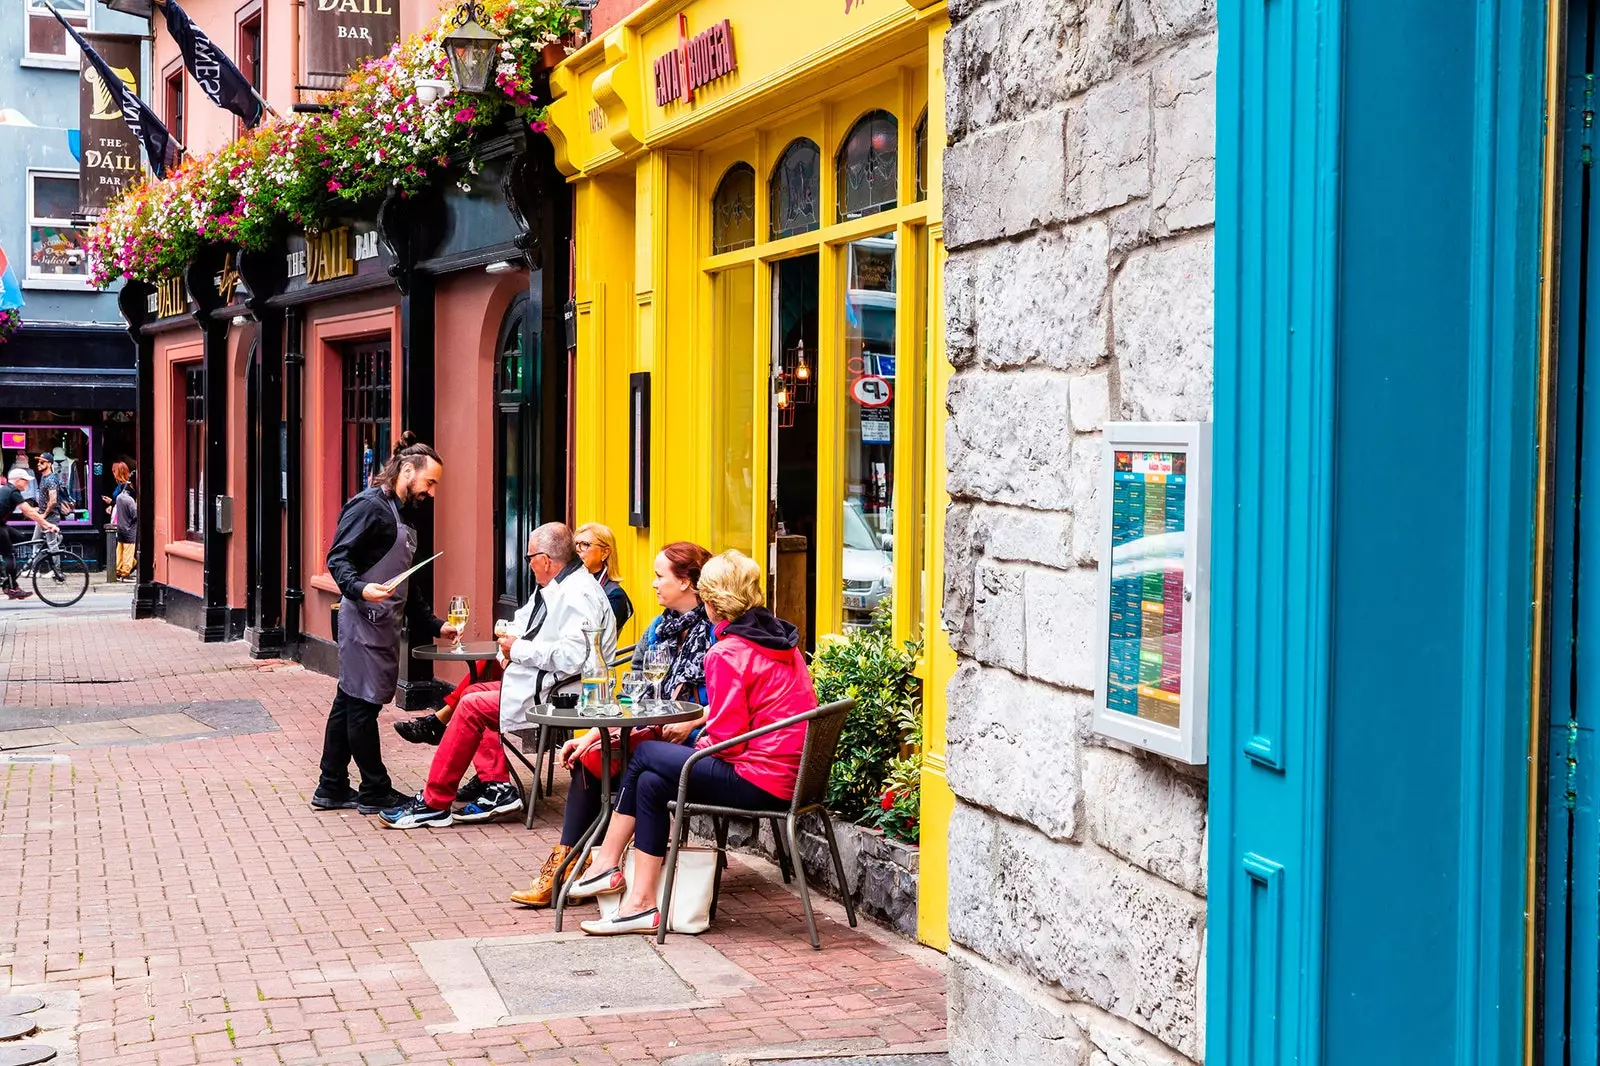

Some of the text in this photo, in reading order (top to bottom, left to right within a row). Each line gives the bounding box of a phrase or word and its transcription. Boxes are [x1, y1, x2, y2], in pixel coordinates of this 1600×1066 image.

[338, 26, 369, 39] BAR
[654, 18, 735, 107] CAVA BODEGA
[99, 138, 122, 147] THE
[99, 176, 121, 185] BAR
[286, 250, 307, 278] THE
[355, 230, 379, 261] BAR
